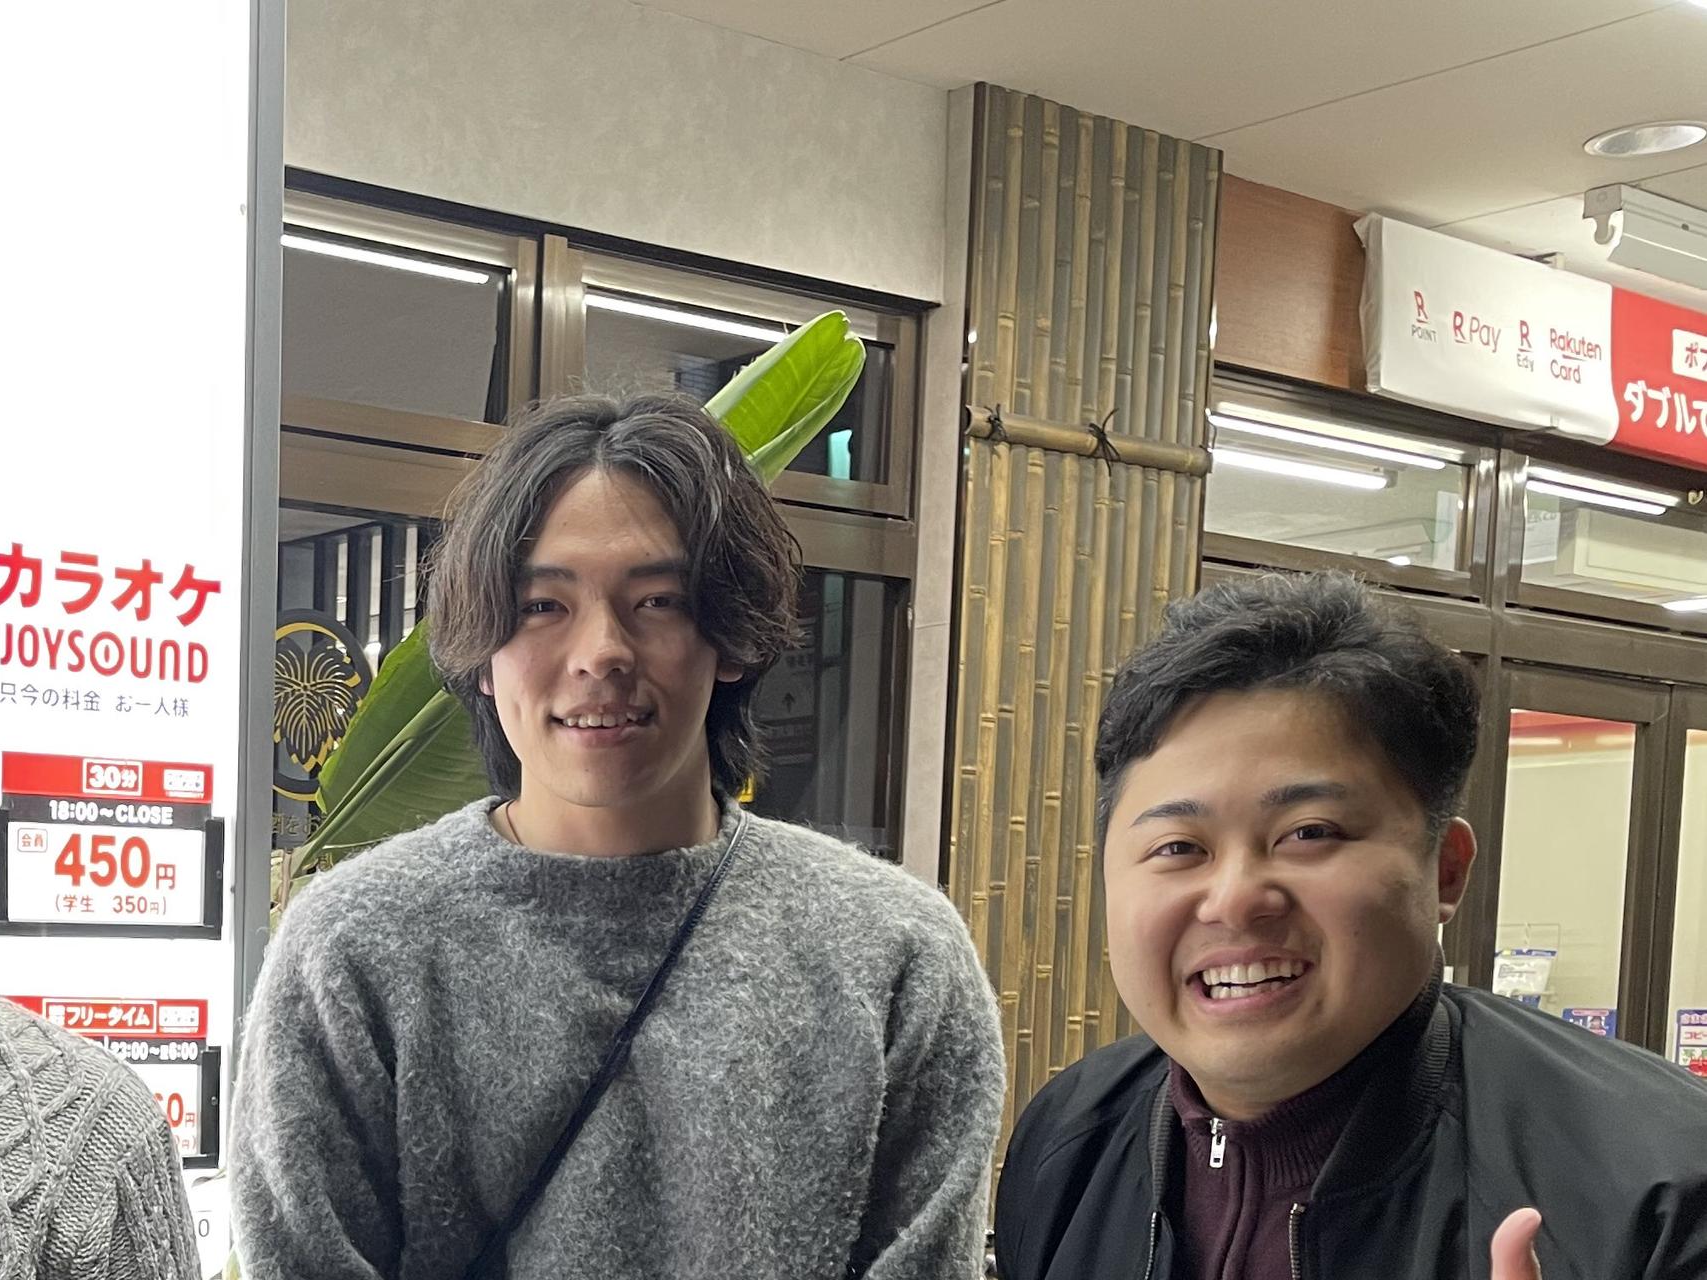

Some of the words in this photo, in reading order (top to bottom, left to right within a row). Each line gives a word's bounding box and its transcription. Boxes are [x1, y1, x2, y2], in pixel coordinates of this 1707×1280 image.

[1411, 325, 1437, 342] POINT
[1469, 317, 1501, 353] Pay
[1550, 328, 1602, 361] Rakuten
[1517, 354, 1534, 372] Edy
[1550, 359, 1582, 384] Card
[0, 623, 209, 683] JOYSOUND
[0, 682, 100, 711] 只今の料金
[115, 695, 189, 717] お一人様
[89, 764, 137, 789] 30分
